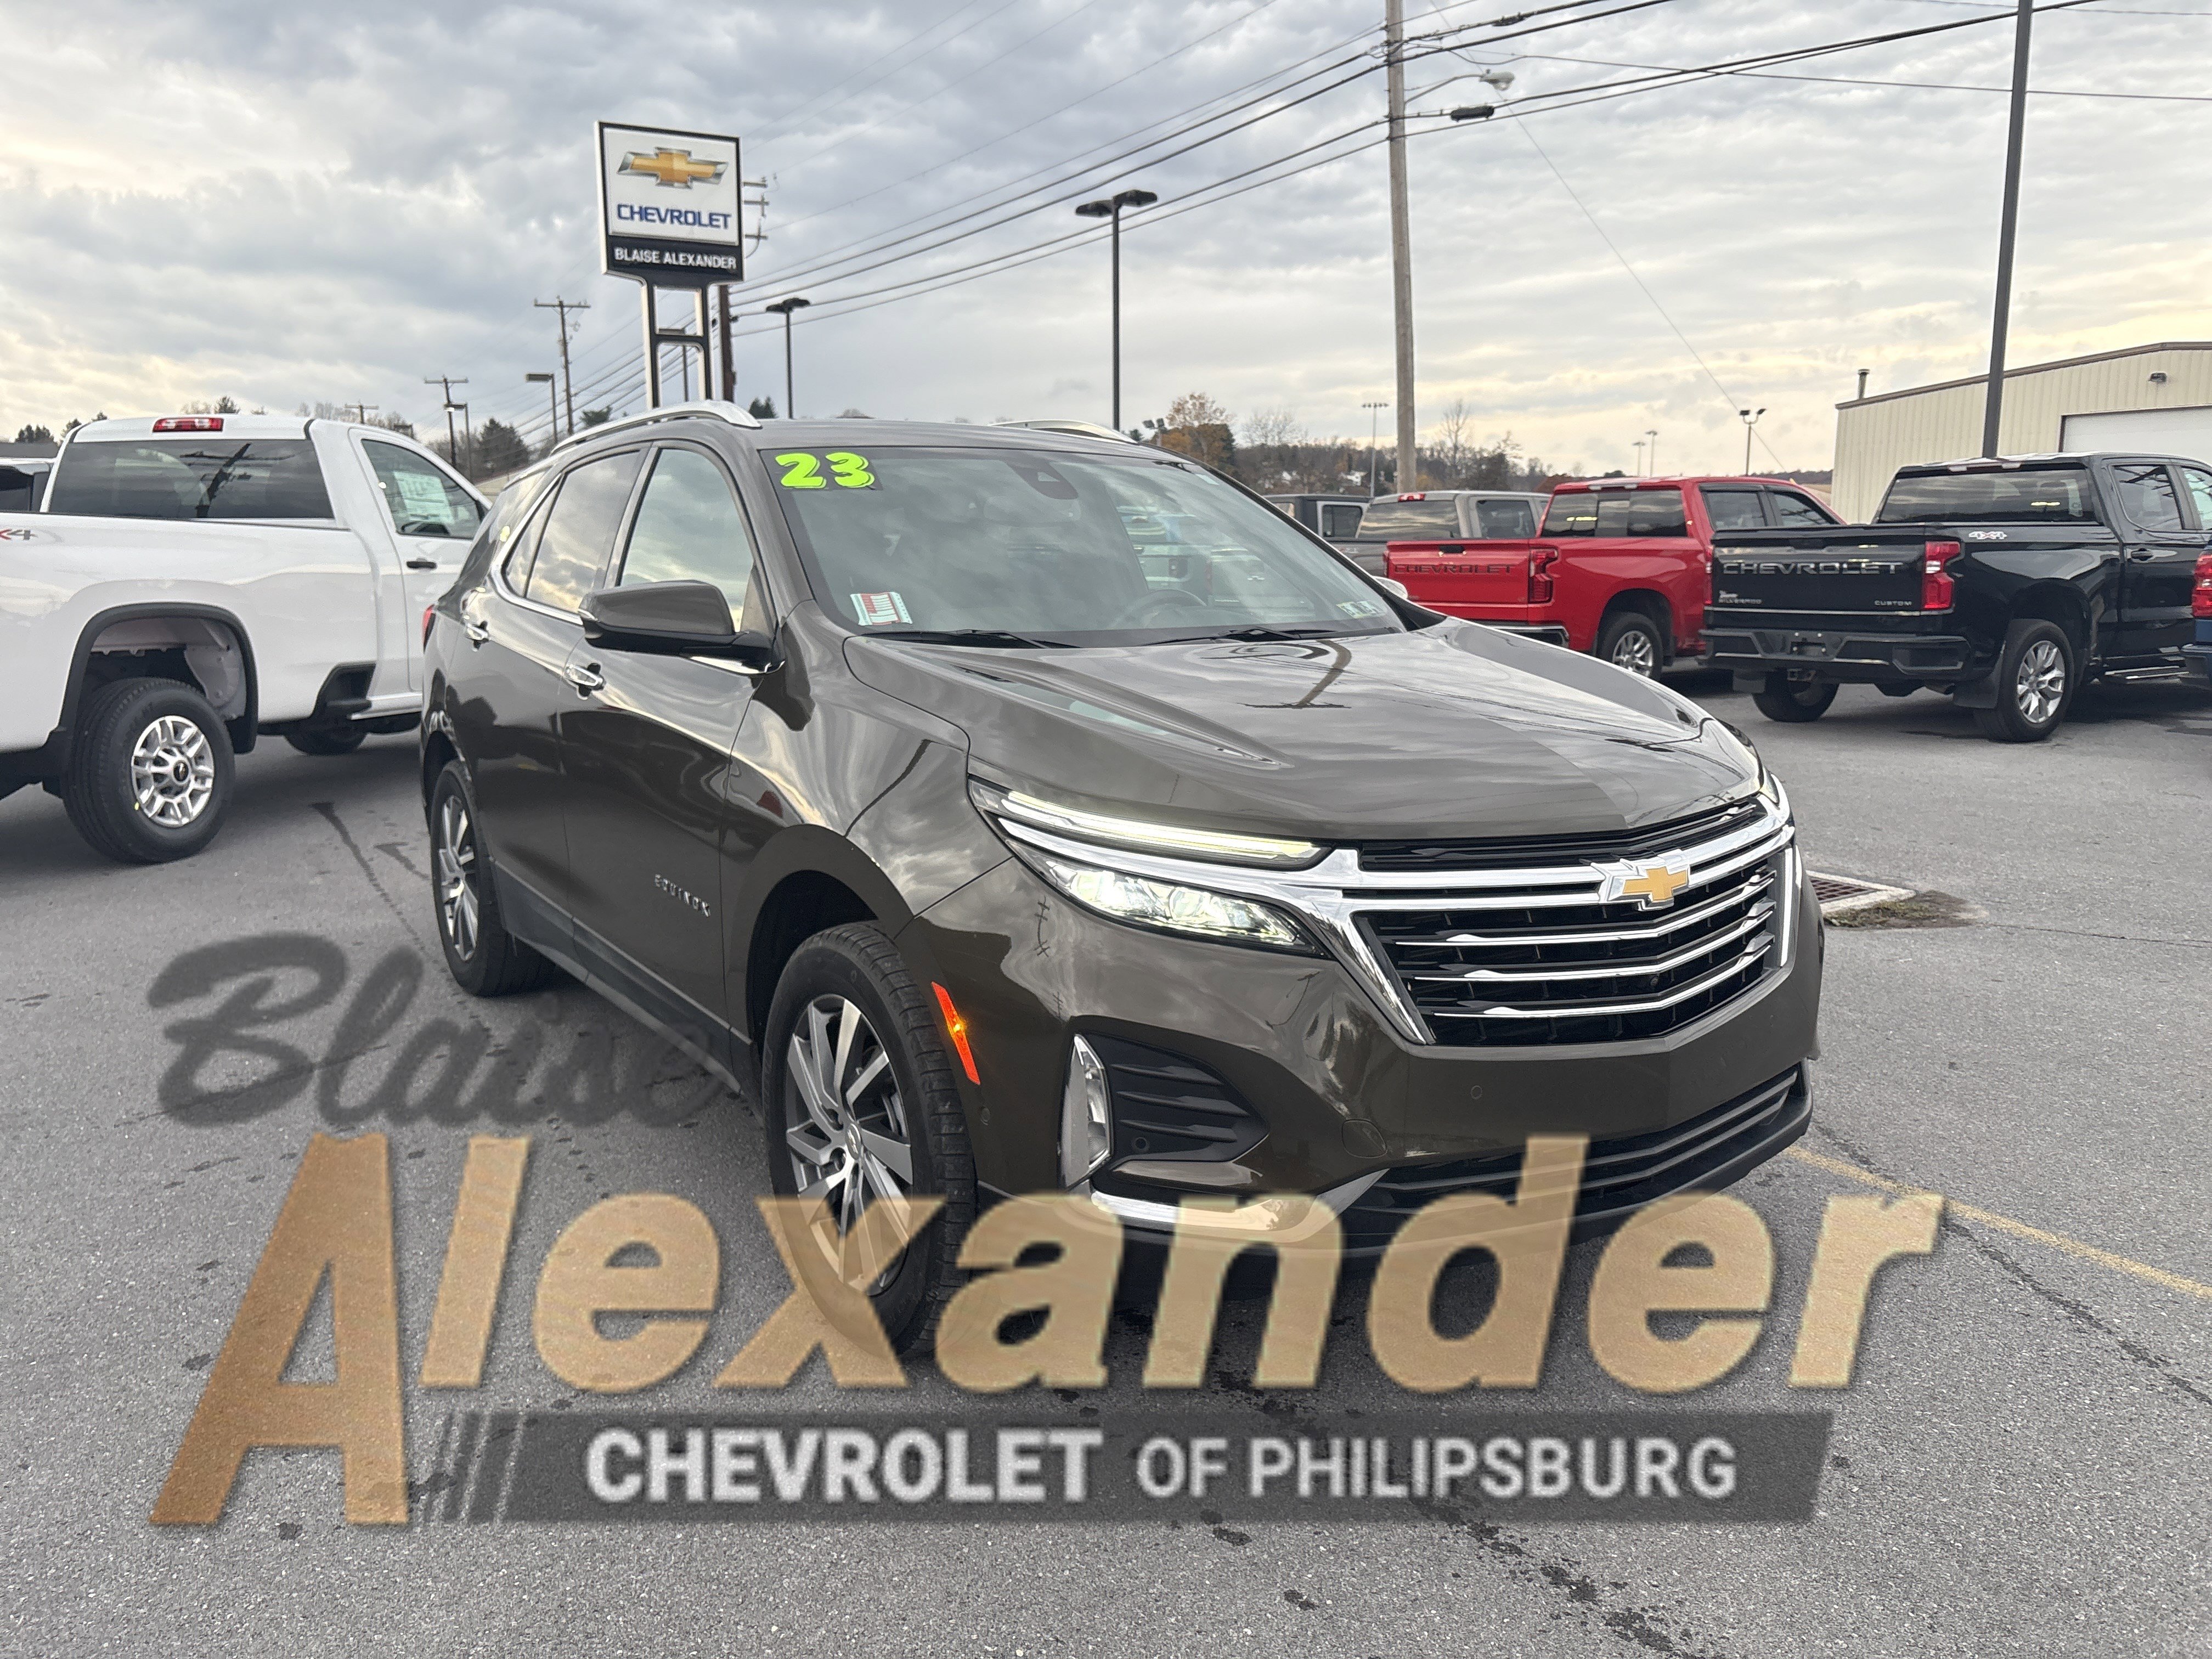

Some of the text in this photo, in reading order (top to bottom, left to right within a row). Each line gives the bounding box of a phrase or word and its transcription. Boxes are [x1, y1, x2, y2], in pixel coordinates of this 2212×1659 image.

[617, 204, 731, 229] CHEVROLET
[614, 247, 737, 269] BLAISE ALEXANDER
[775, 452, 874, 488] 23
[1395, 563, 1512, 574] CHEVROLET
[1723, 562, 1904, 575] CHEVROLET
[654, 873, 711, 917] EQUINOX
